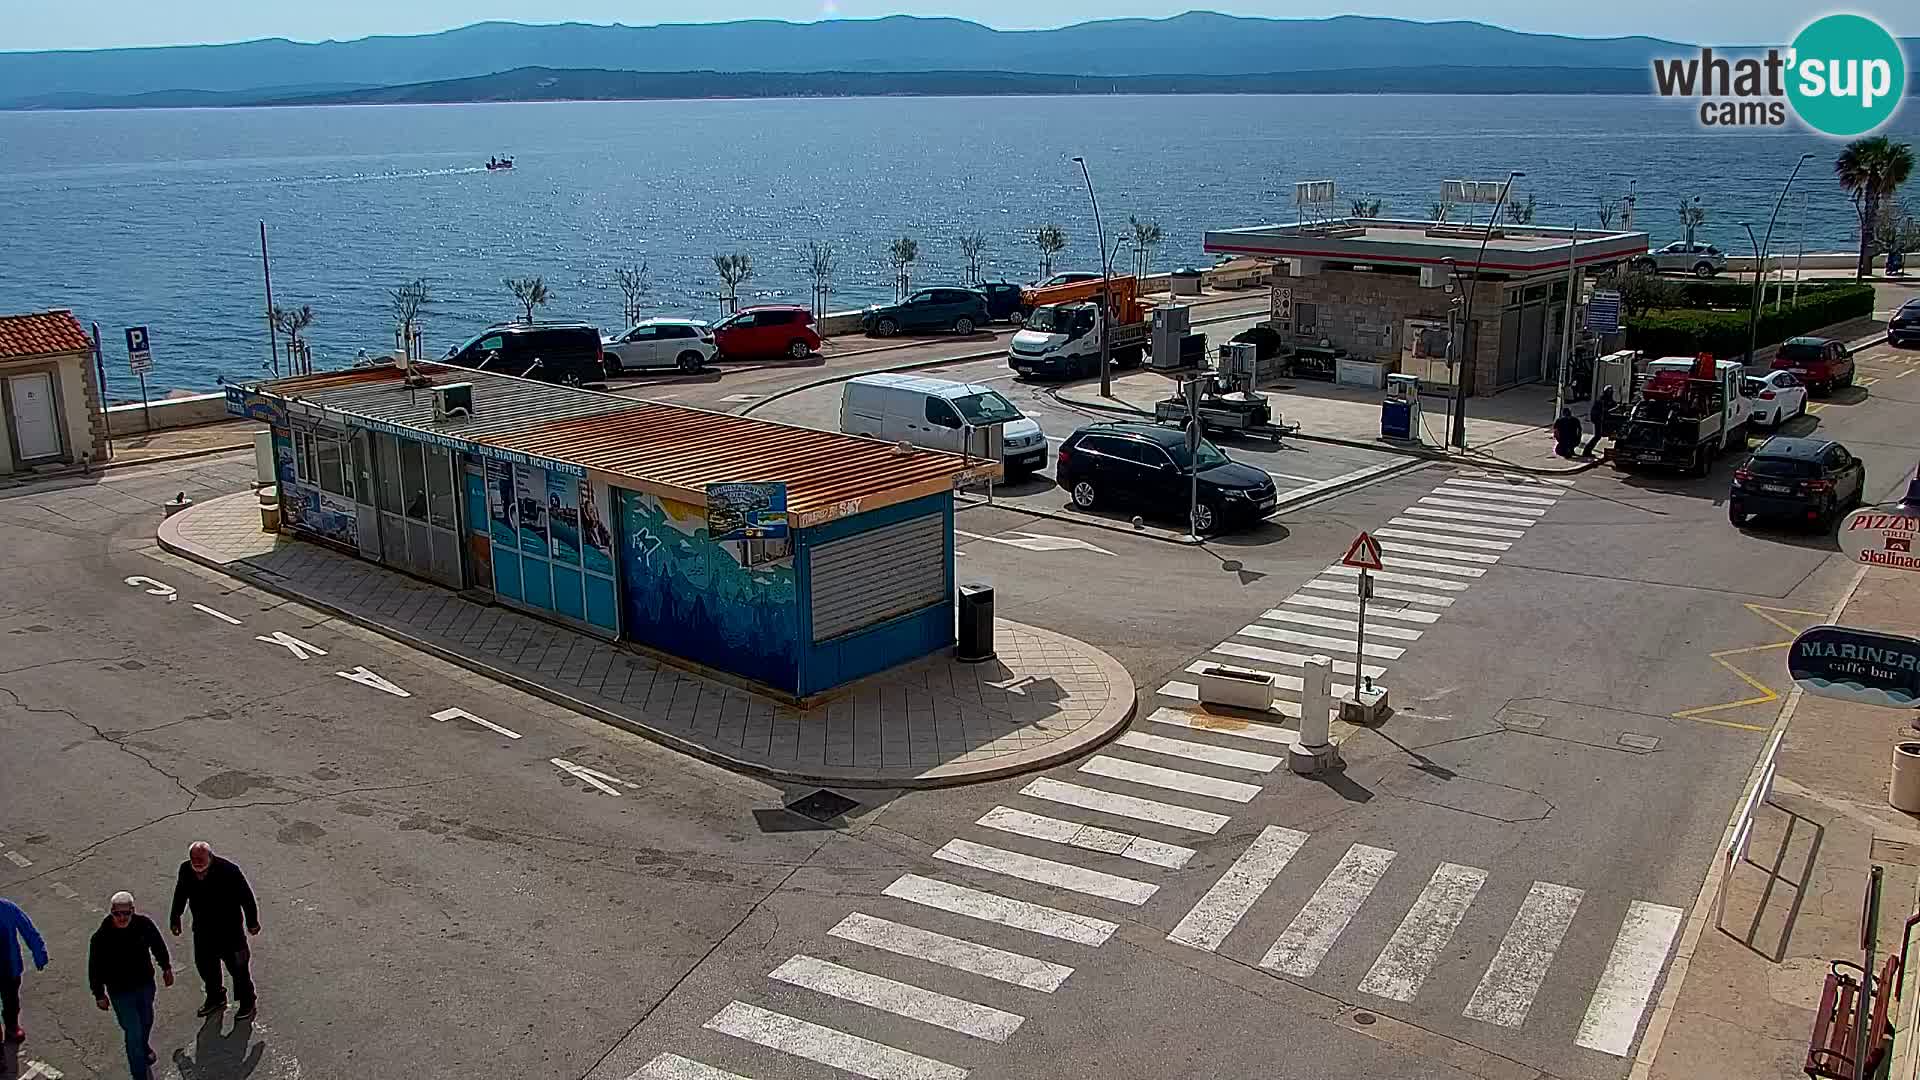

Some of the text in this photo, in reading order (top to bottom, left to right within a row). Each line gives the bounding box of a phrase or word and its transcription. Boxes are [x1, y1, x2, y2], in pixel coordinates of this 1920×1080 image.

[131, 331, 143, 348] P
[479, 445, 583, 477] BUS STATION TICKET OFFICE
[1848, 514, 1920, 532] PIZZE
[1882, 529, 1914, 539] GRILL
[1829, 661, 1897, 680] caffe bar
